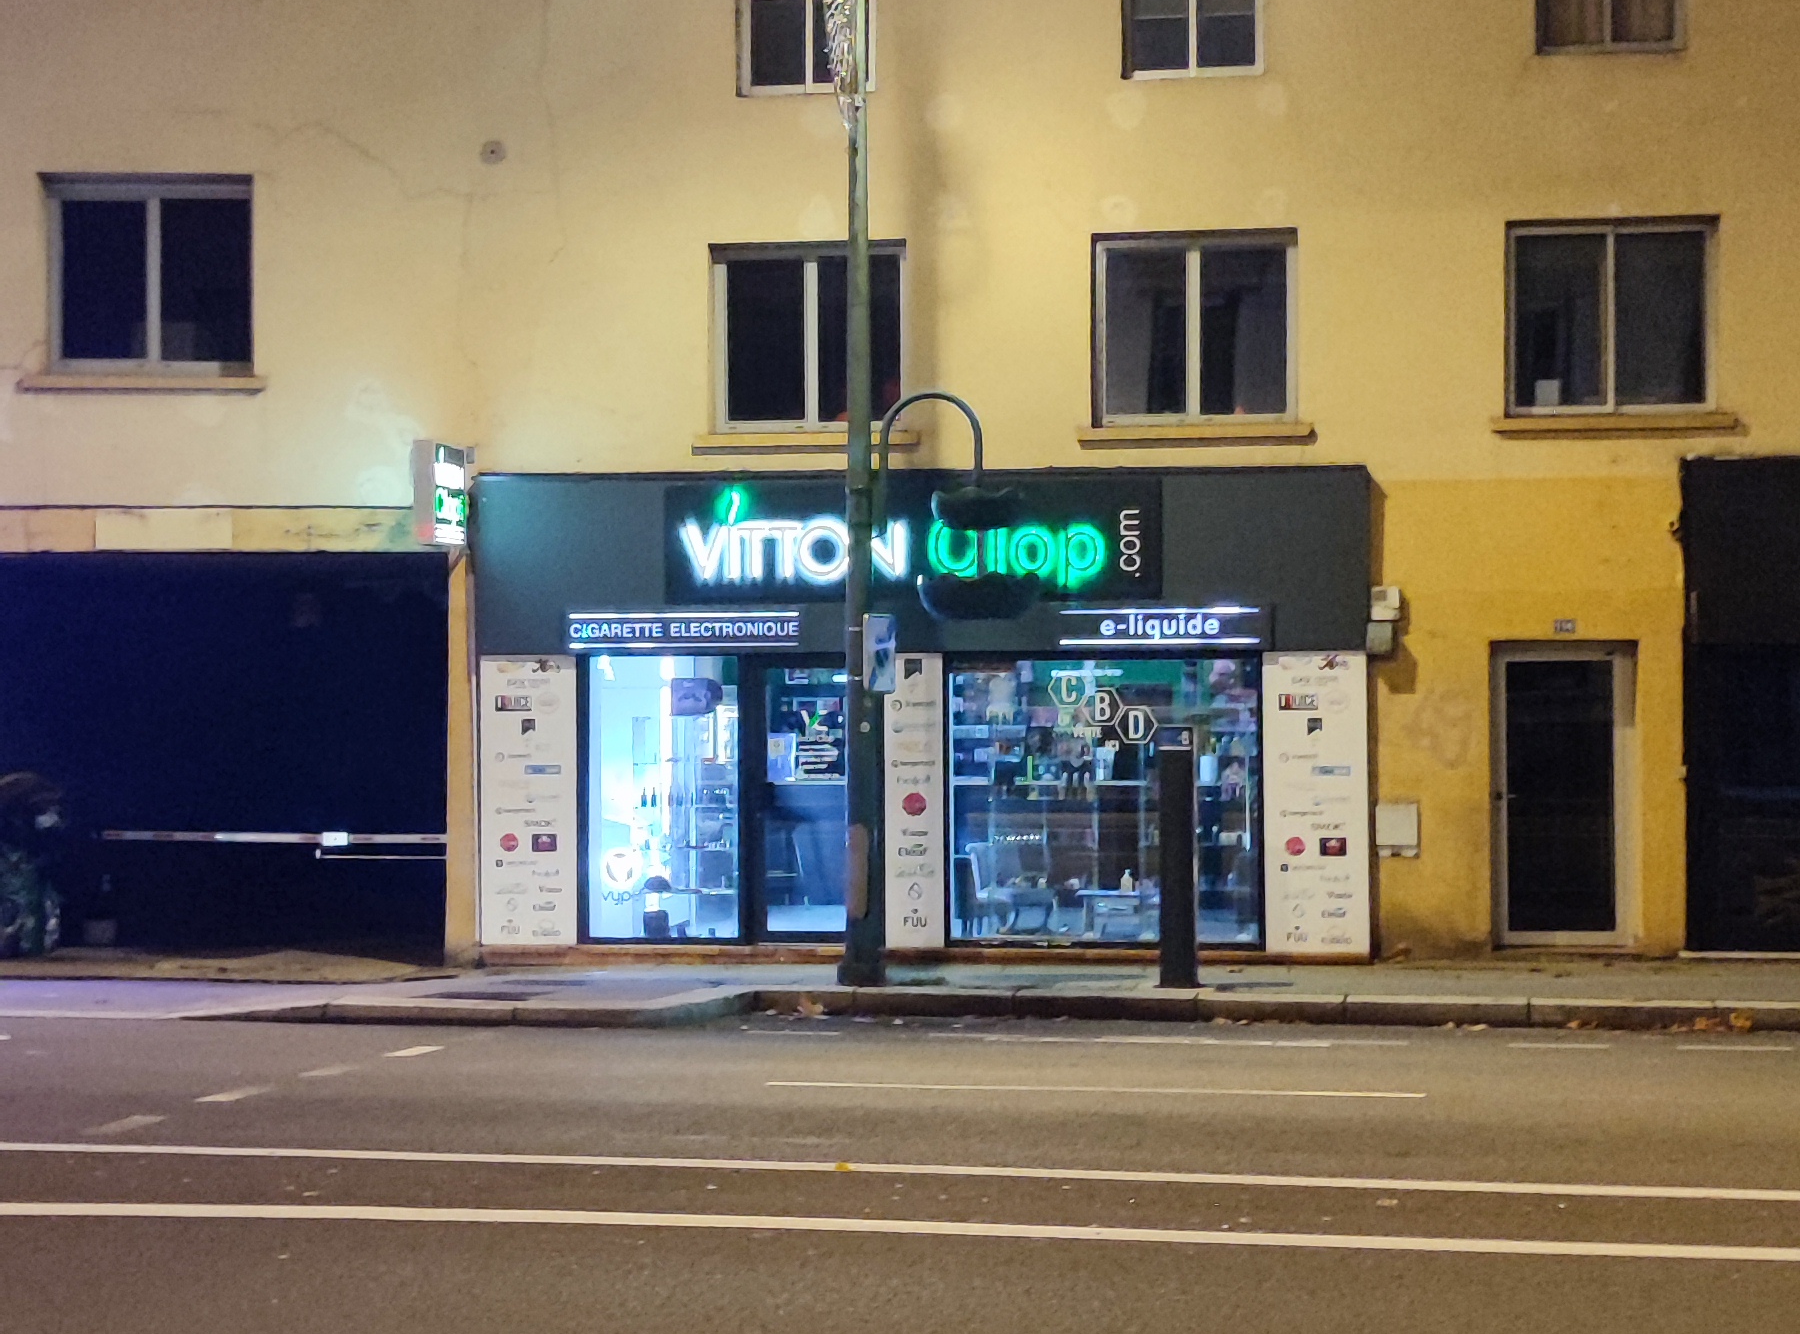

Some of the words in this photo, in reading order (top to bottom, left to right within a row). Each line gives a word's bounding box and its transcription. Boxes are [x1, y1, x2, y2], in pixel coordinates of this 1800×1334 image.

[1119, 509, 1142, 578] .com
[569, 623, 664, 639] CIGARETTE
[670, 621, 799, 638] ELECTRONIQUE
[1099, 613, 1221, 640] e-liquide
